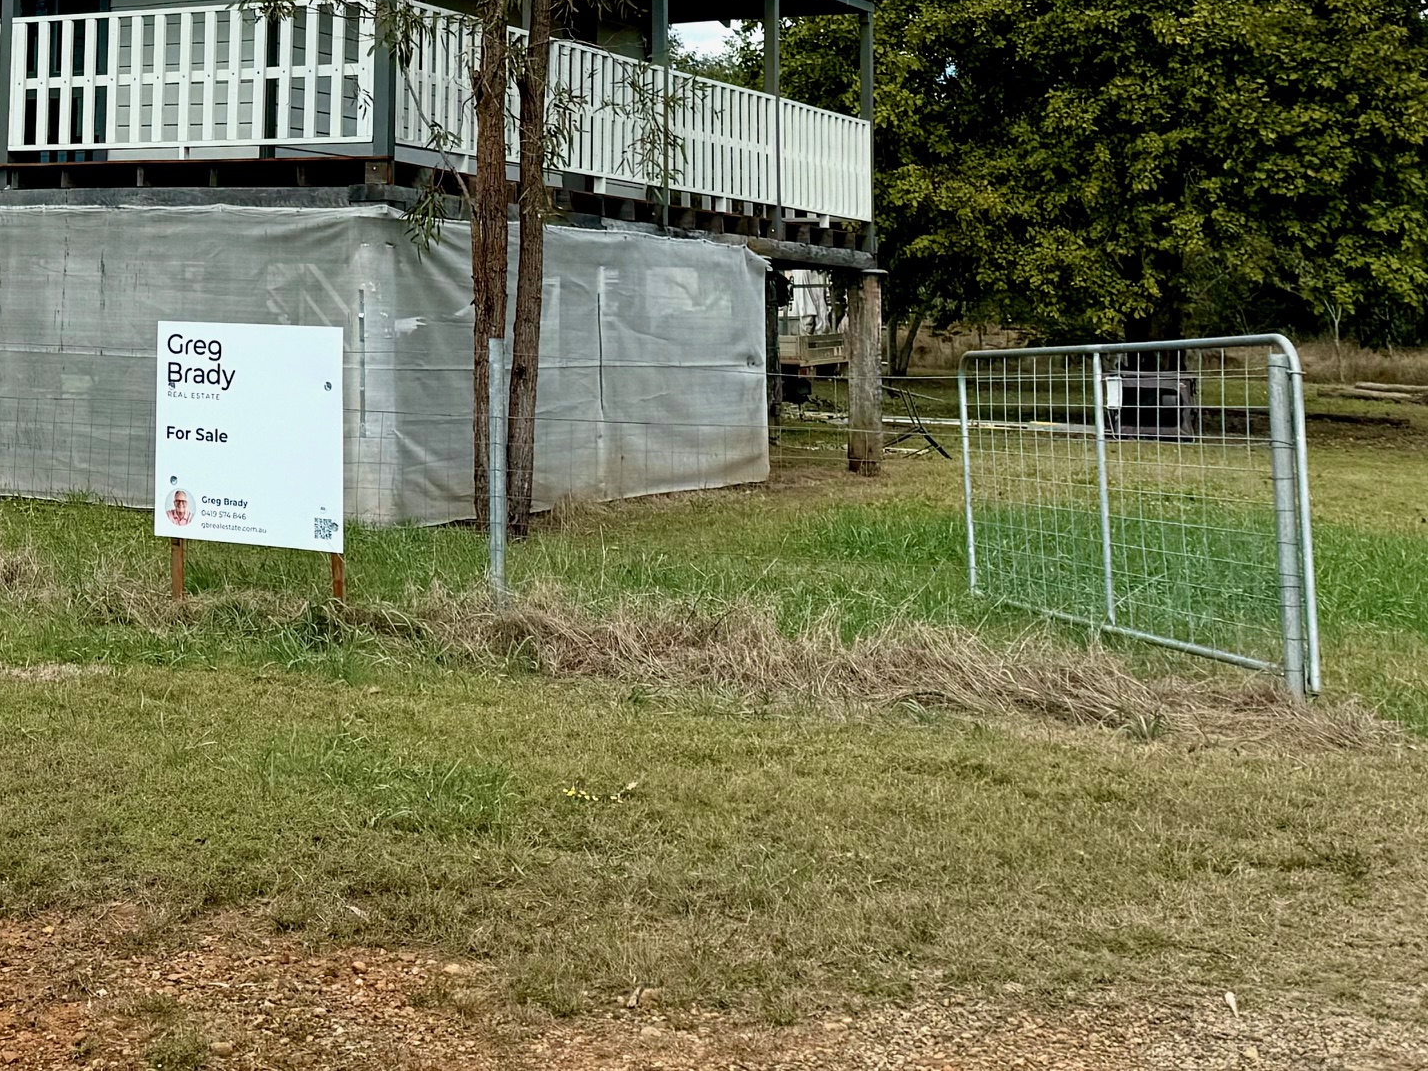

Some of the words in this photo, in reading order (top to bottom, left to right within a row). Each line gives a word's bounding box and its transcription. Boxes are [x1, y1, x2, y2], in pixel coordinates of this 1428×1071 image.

[167, 334, 222, 361] Greg
[167, 362, 236, 391] Brady
[167, 391, 188, 399] REAL
[166, 426, 191, 440] For
[195, 427, 228, 443] Sale
[201, 495, 221, 506] Greg
[223, 498, 248, 508] Brady
[201, 509, 217, 517] 0419
[218, 510, 231, 518] 574
[232, 512, 247, 520] 846
[201, 522, 267, 533] gbrealestate.com.au
